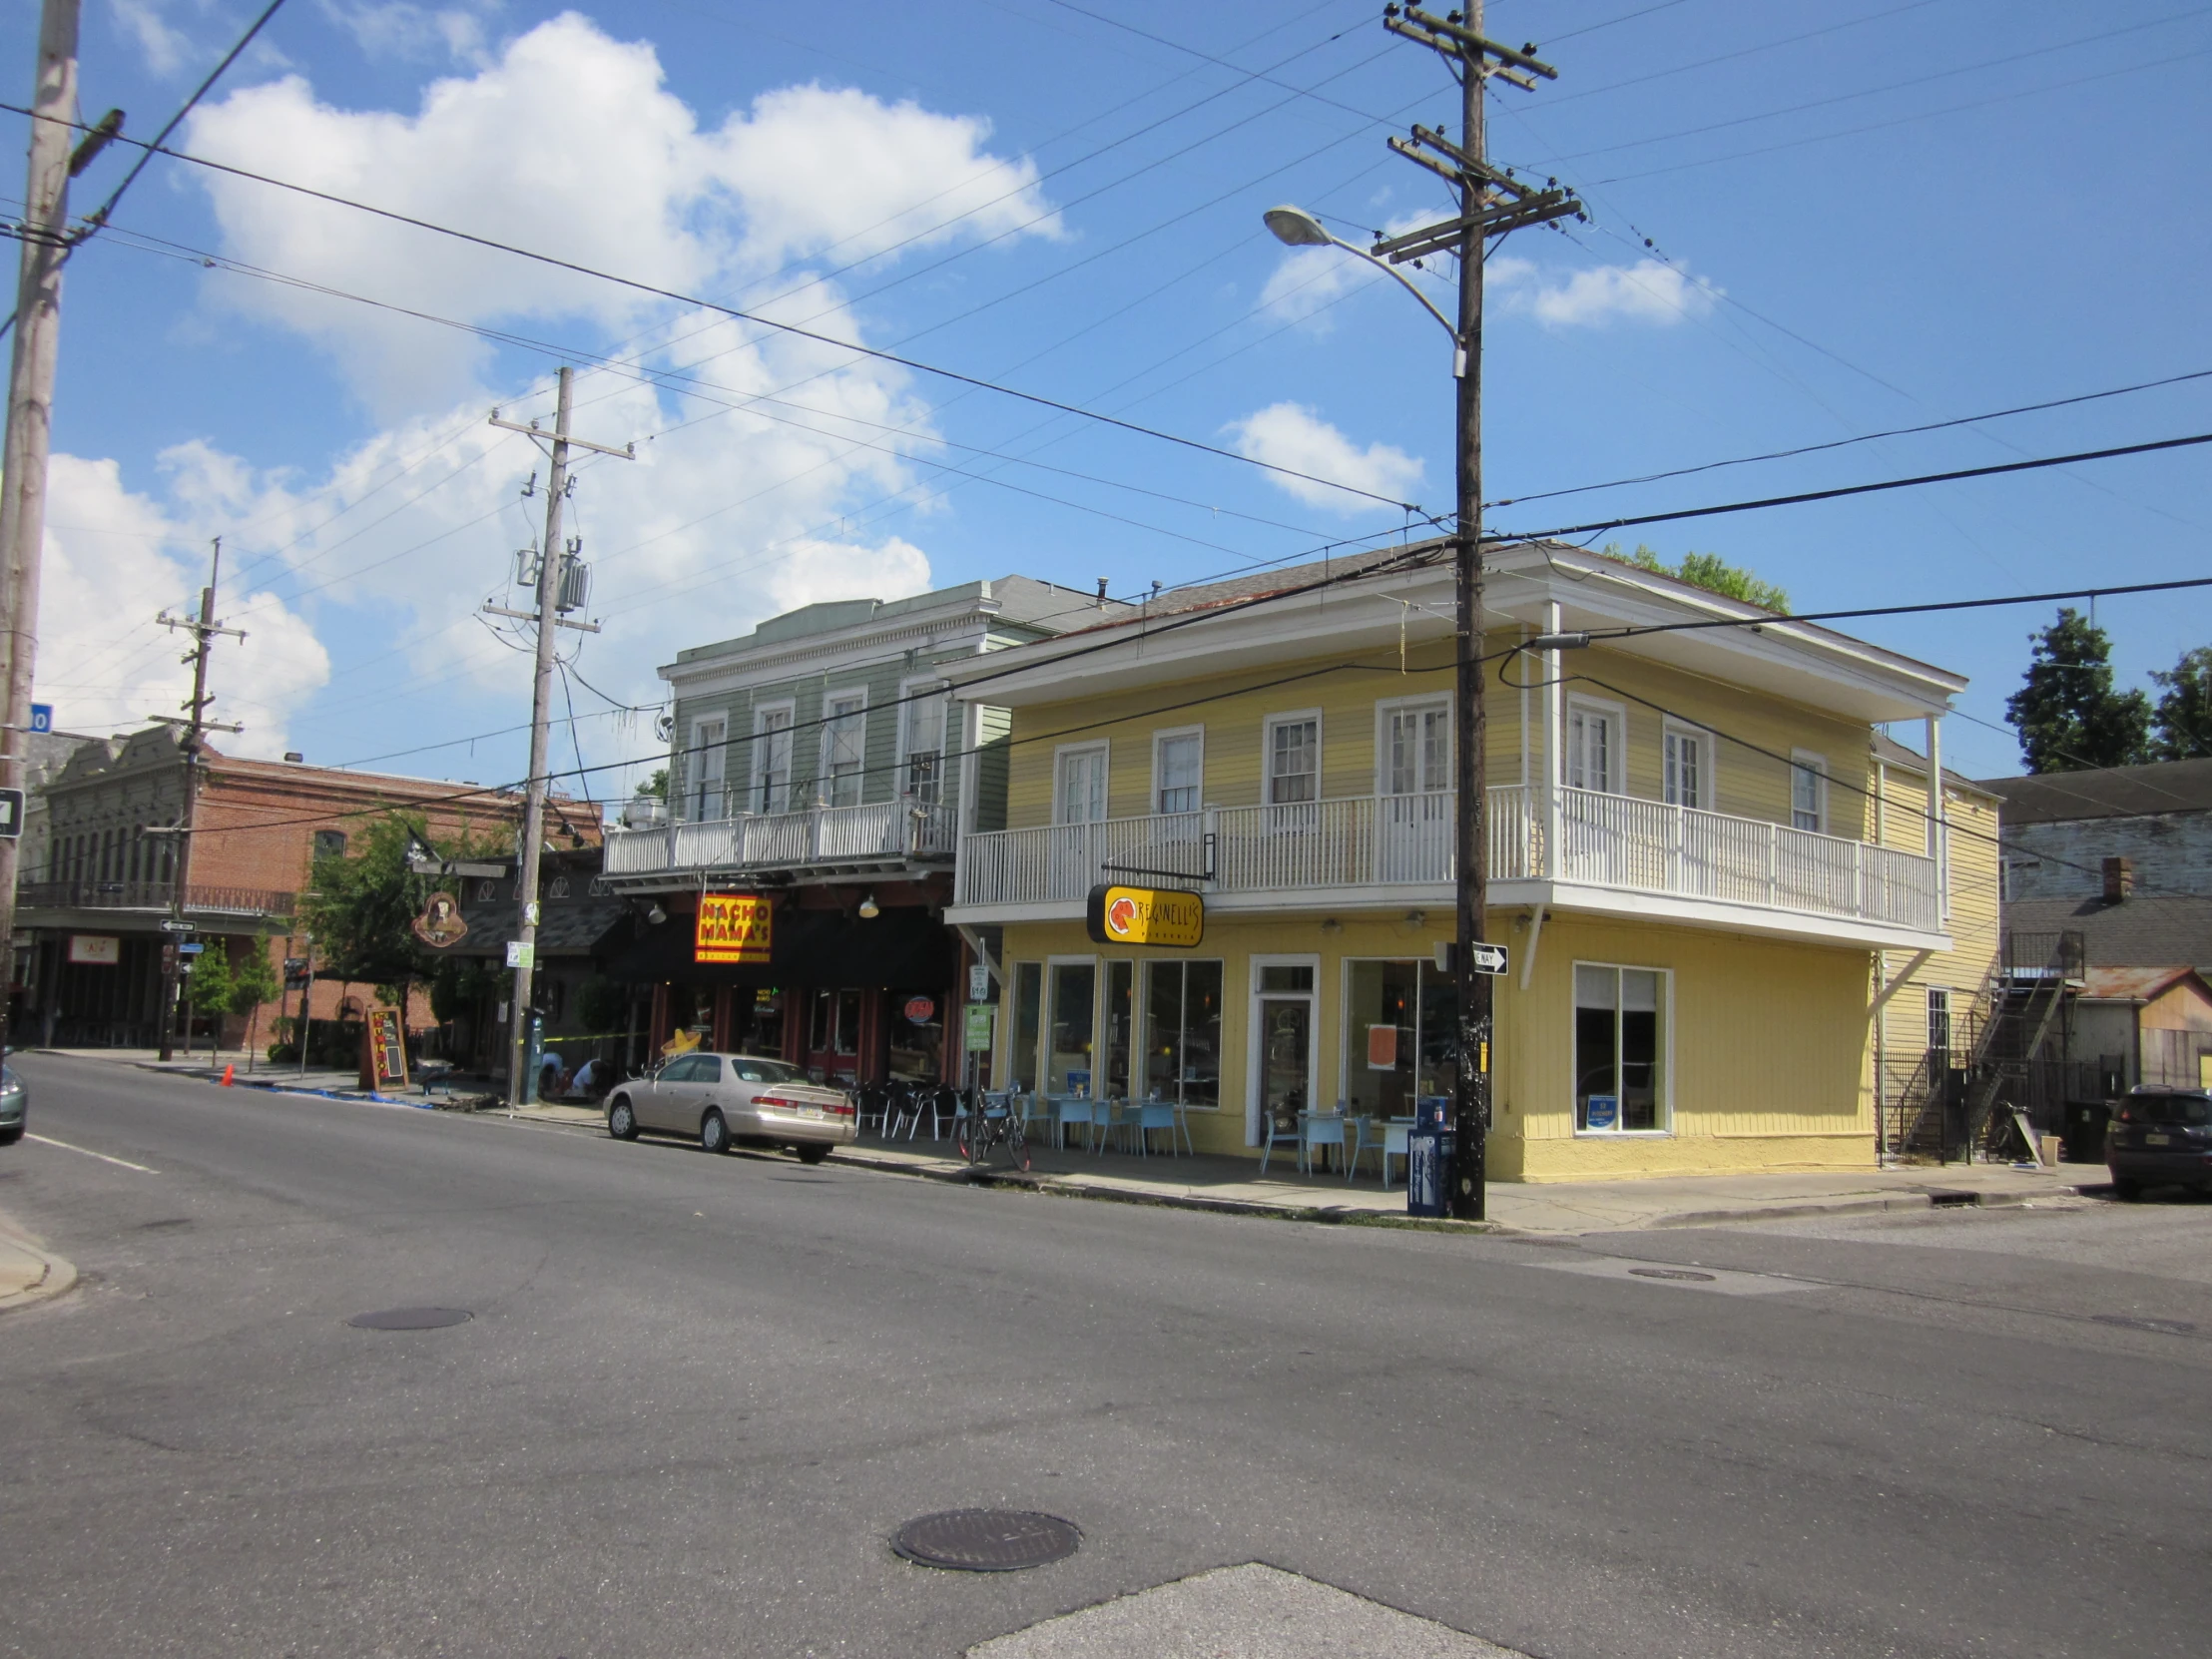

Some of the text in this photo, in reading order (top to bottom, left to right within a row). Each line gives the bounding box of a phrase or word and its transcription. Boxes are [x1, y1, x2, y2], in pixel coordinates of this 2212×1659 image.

[701, 903, 769, 921] NACHO
[1138, 901, 1199, 931] REGINELLI'S
[700, 924, 769, 941] MAMA'S
[1481, 953, 1494, 965] WAY
